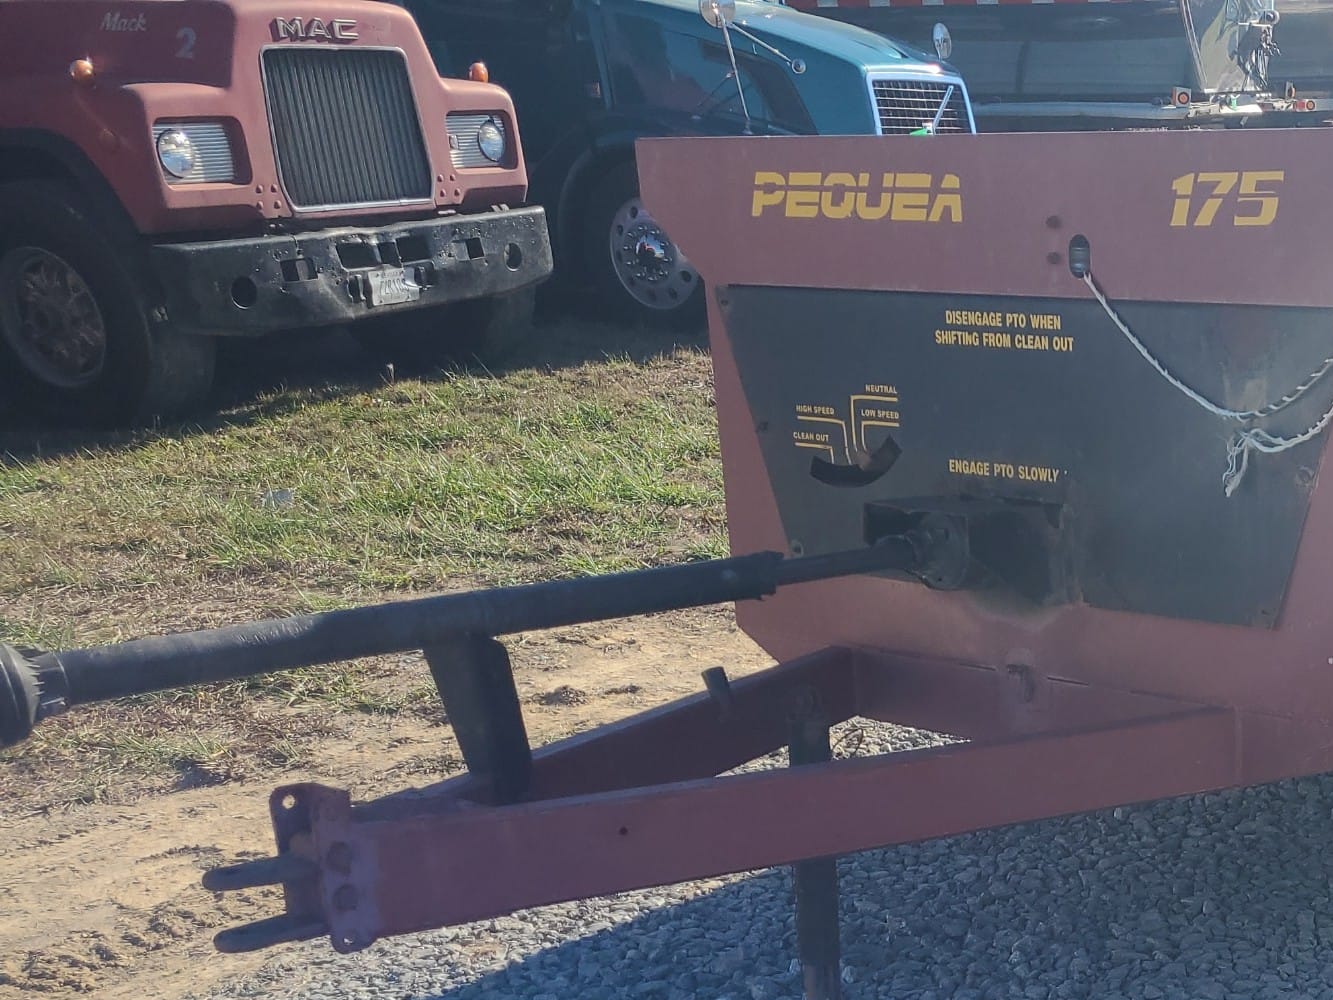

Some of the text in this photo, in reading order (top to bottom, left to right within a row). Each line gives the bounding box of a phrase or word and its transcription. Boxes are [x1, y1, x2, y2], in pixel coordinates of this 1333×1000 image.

[101, 11, 147, 31] Mack
[274, 16, 359, 40] MAC
[175, 27, 196, 58] 2
[752, 171, 963, 222] PEQUEA
[1169, 170, 1284, 226] 175
[945, 310, 1061, 330] DISENGAGE PTO WHEN
[935, 330, 1074, 352] SHIFTING FROM CLEAN OUT
[865, 384, 898, 394] NEUTRAL
[796, 404, 835, 415] HIGH SPEED
[861, 408, 899, 420] LOW SPEED
[793, 431, 829, 442] CLEAN OUT
[949, 459, 1059, 483] ENGAGE PTO SLOWLY
